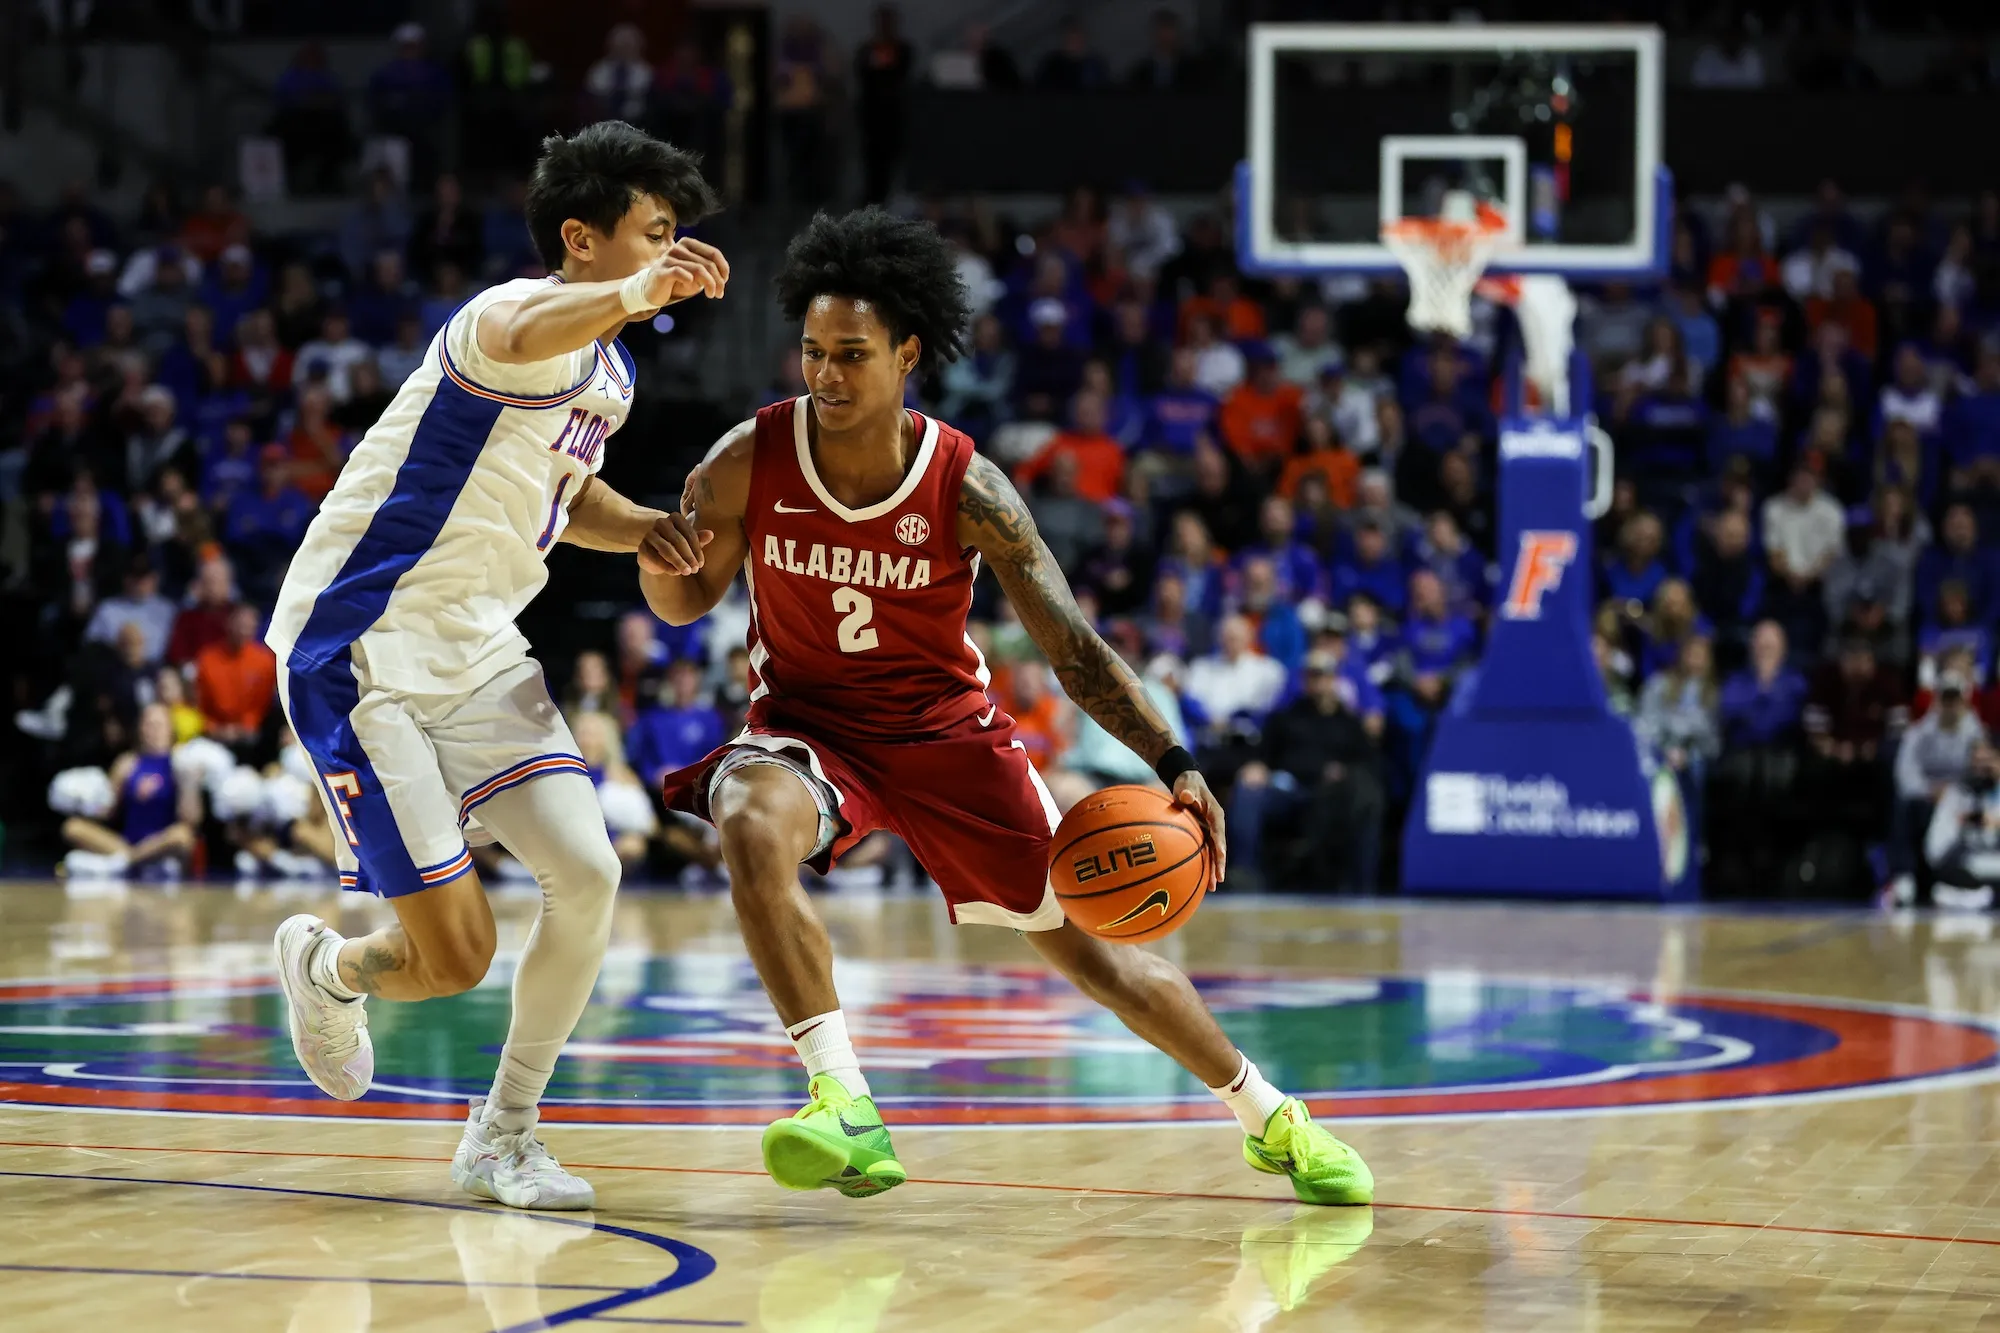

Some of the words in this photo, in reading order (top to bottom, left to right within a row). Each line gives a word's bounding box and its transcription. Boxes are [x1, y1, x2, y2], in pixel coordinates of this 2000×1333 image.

[536, 472, 572, 551] 1
[898, 516, 927, 544] SEC
[764, 534, 931, 590] ALABAMA
[1502, 530, 1578, 620] F
[832, 585, 880, 652] 2
[323, 770, 363, 846] F
[1073, 840, 1158, 885] ELITE
